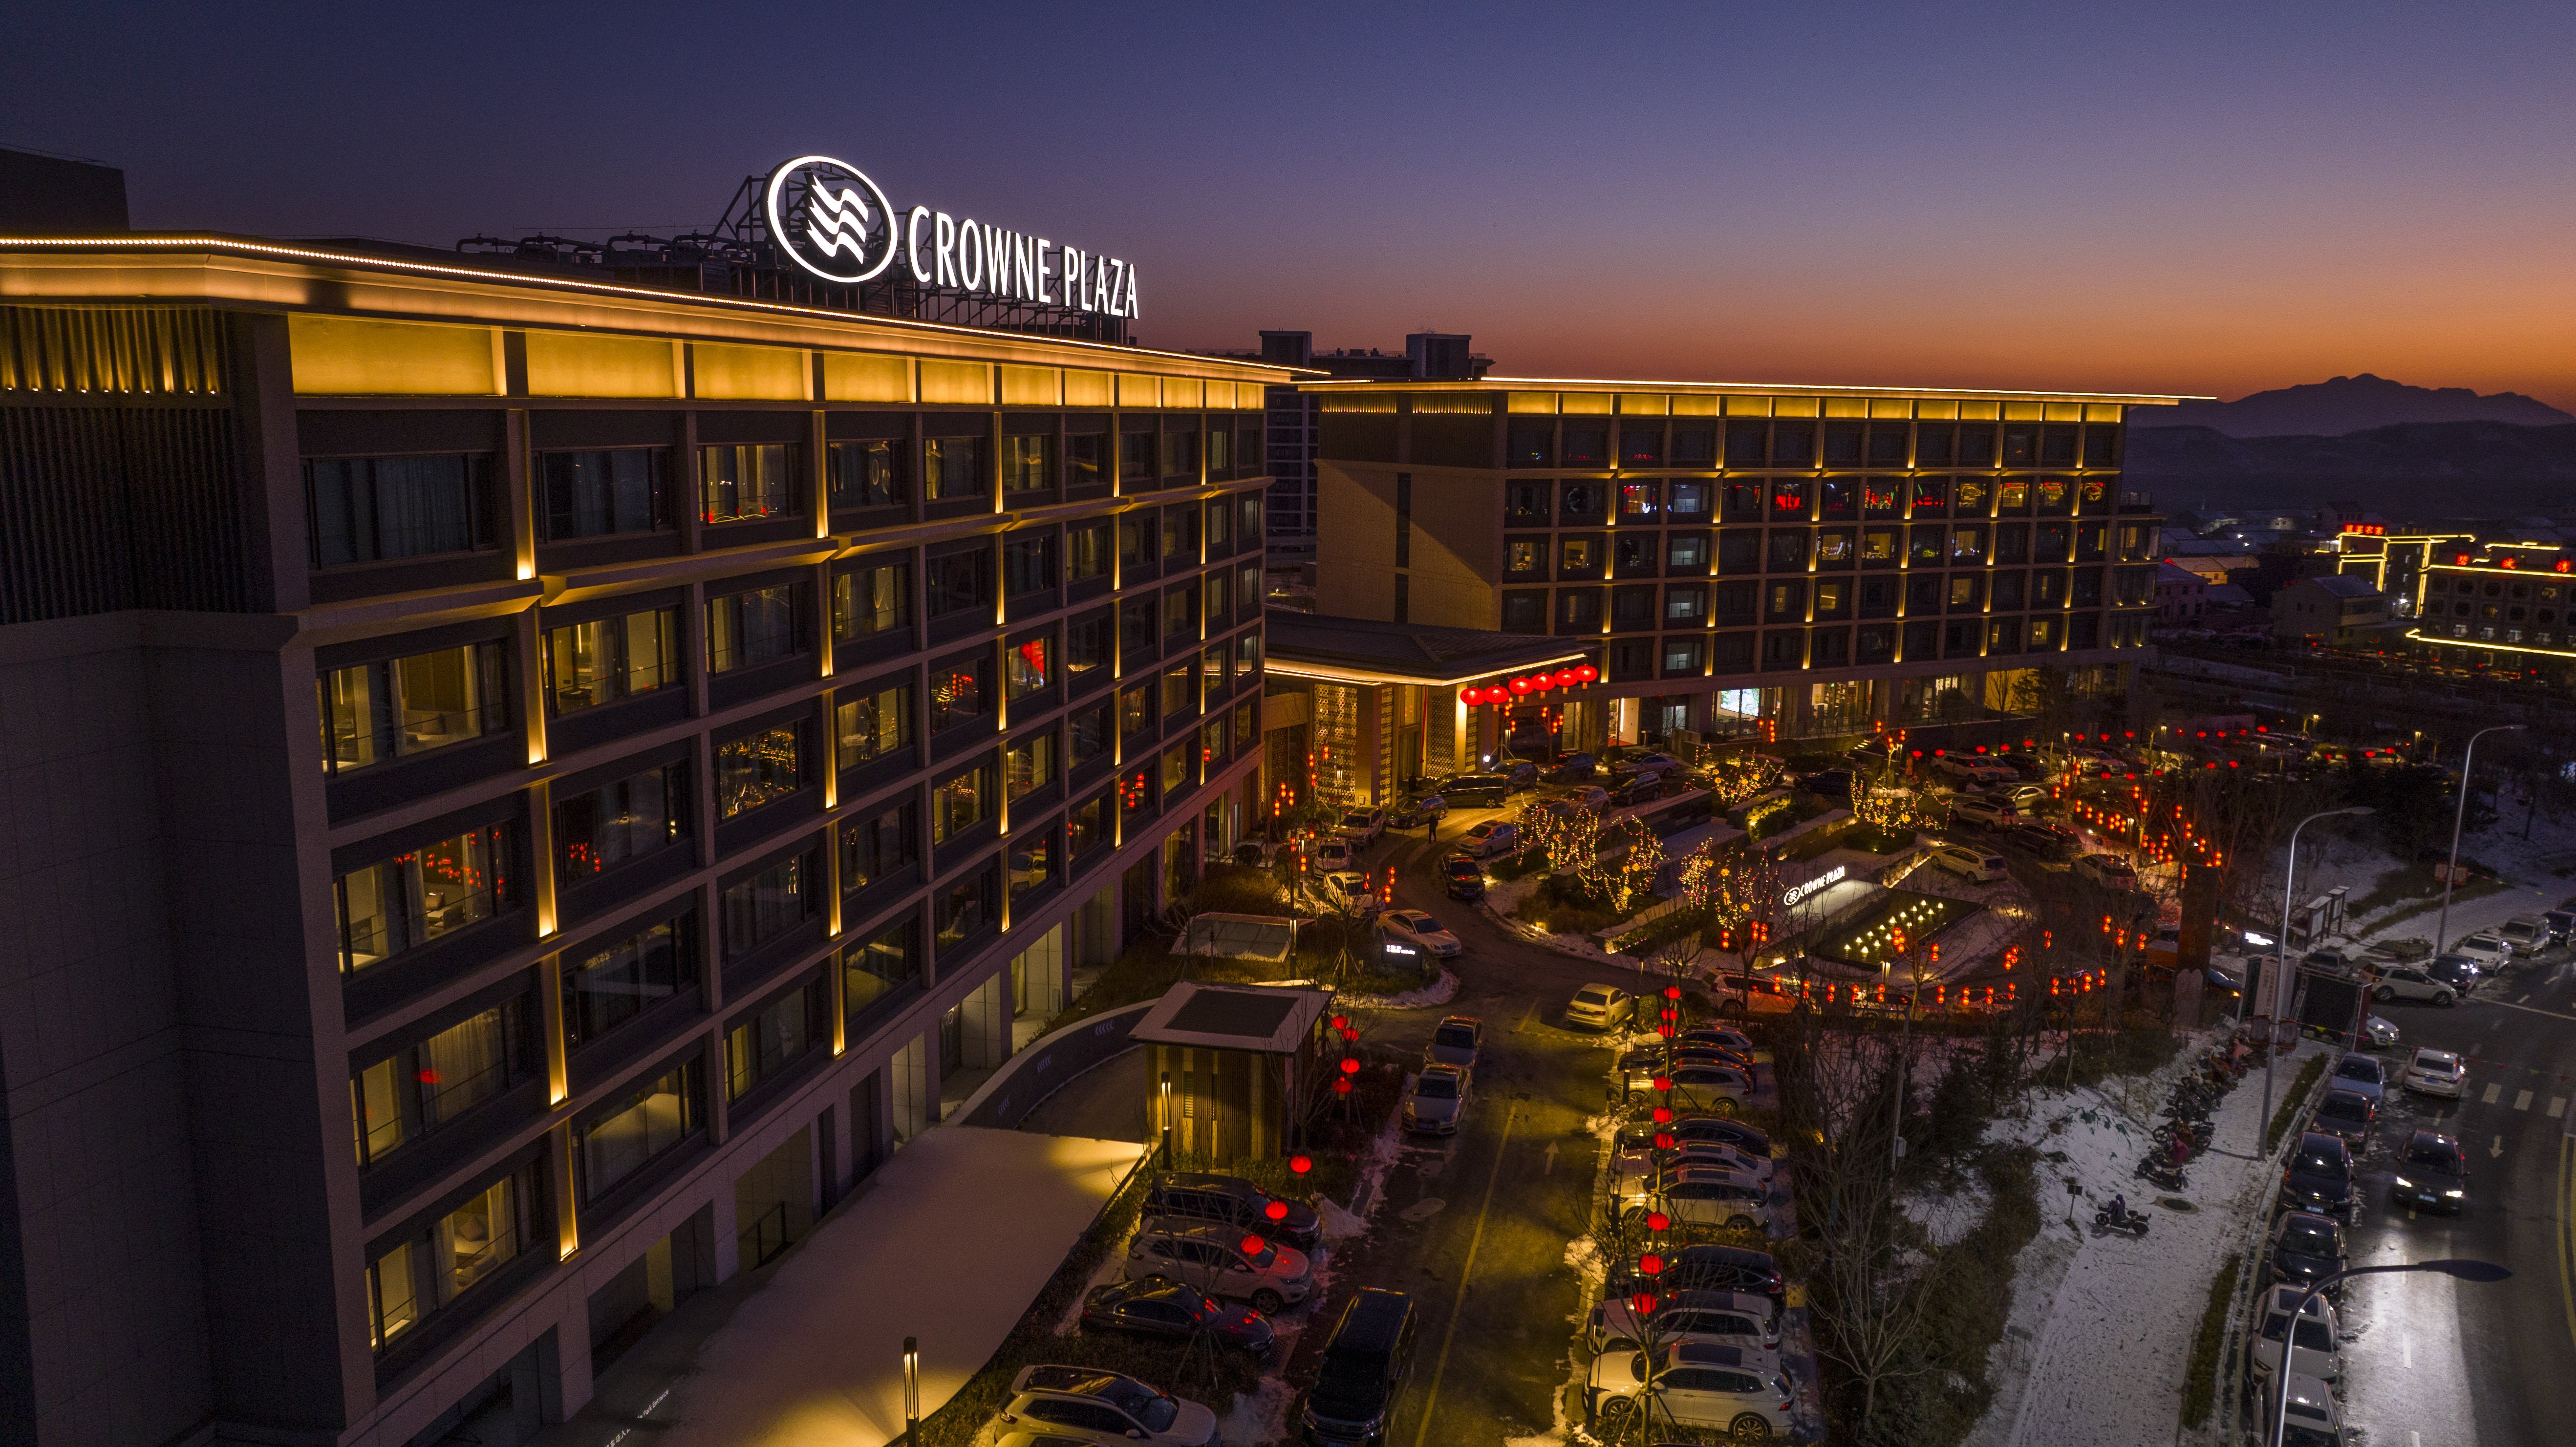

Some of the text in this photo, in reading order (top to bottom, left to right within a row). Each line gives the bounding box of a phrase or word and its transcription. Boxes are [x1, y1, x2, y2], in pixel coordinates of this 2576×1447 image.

[907, 206, 1139, 319] CROWNE PLAZA
[1801, 866, 1845, 896] CROWNE PLAZA
[652, 1389, 669, 1408] Entrance
